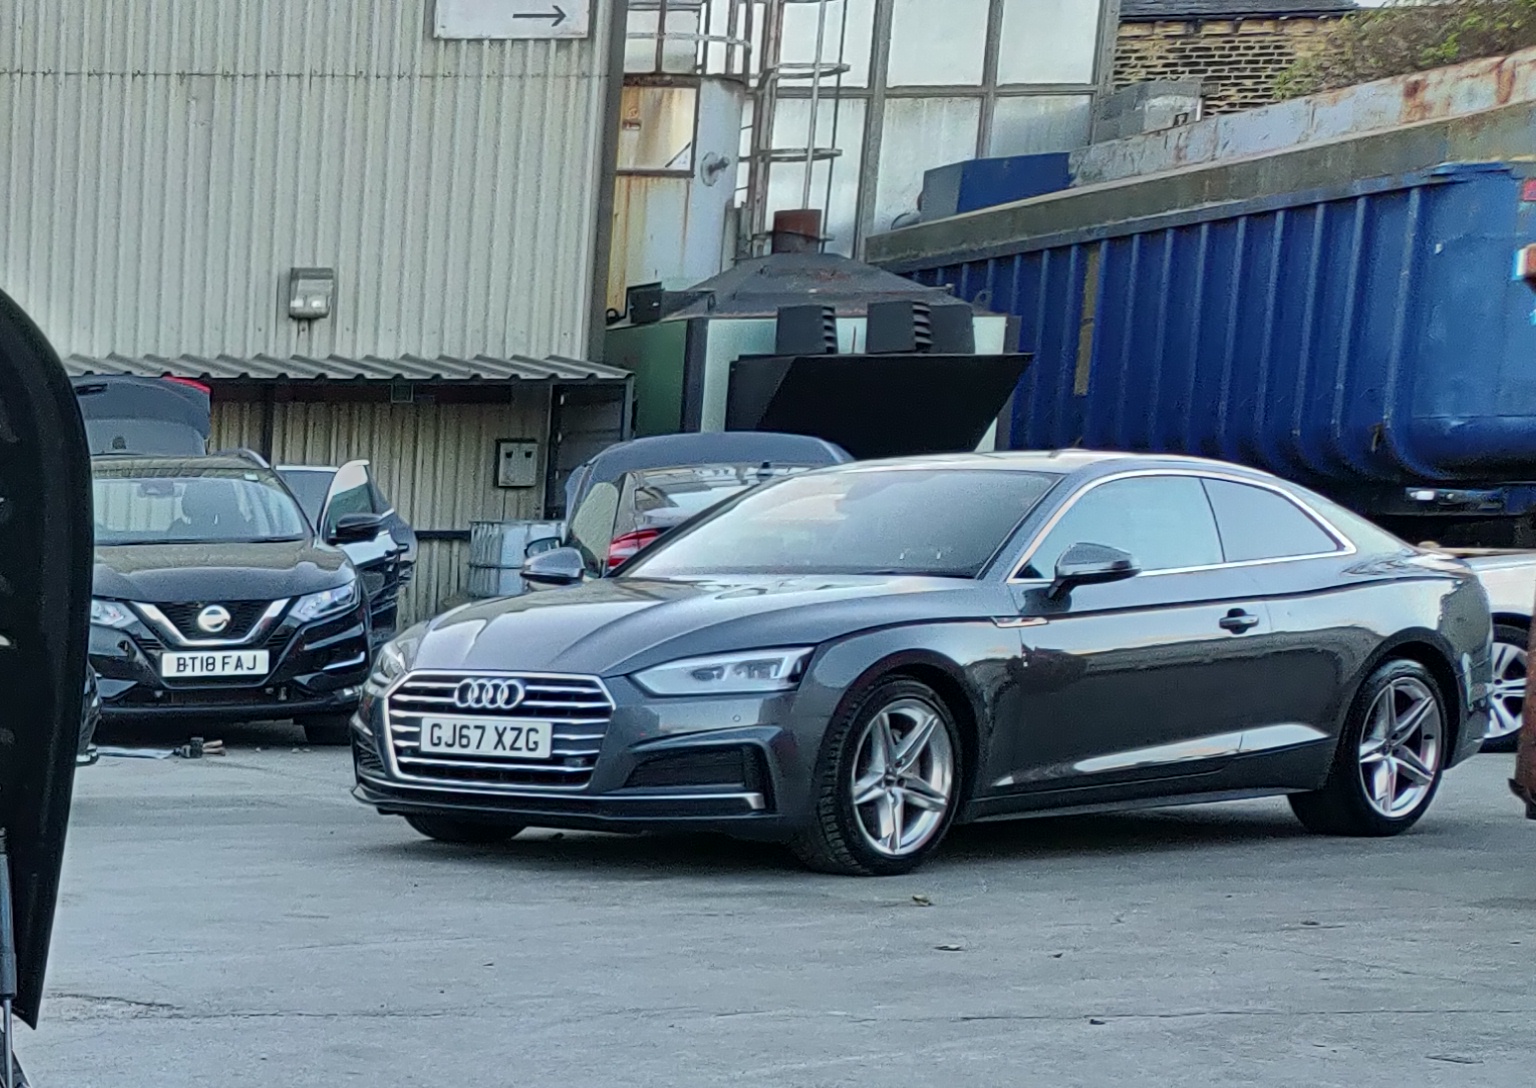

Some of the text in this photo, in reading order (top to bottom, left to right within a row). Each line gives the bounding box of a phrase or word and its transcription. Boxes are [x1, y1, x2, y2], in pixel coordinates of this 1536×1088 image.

[221, 654, 257, 672] FAJ
[429, 722, 540, 752] GJ67 XZG
